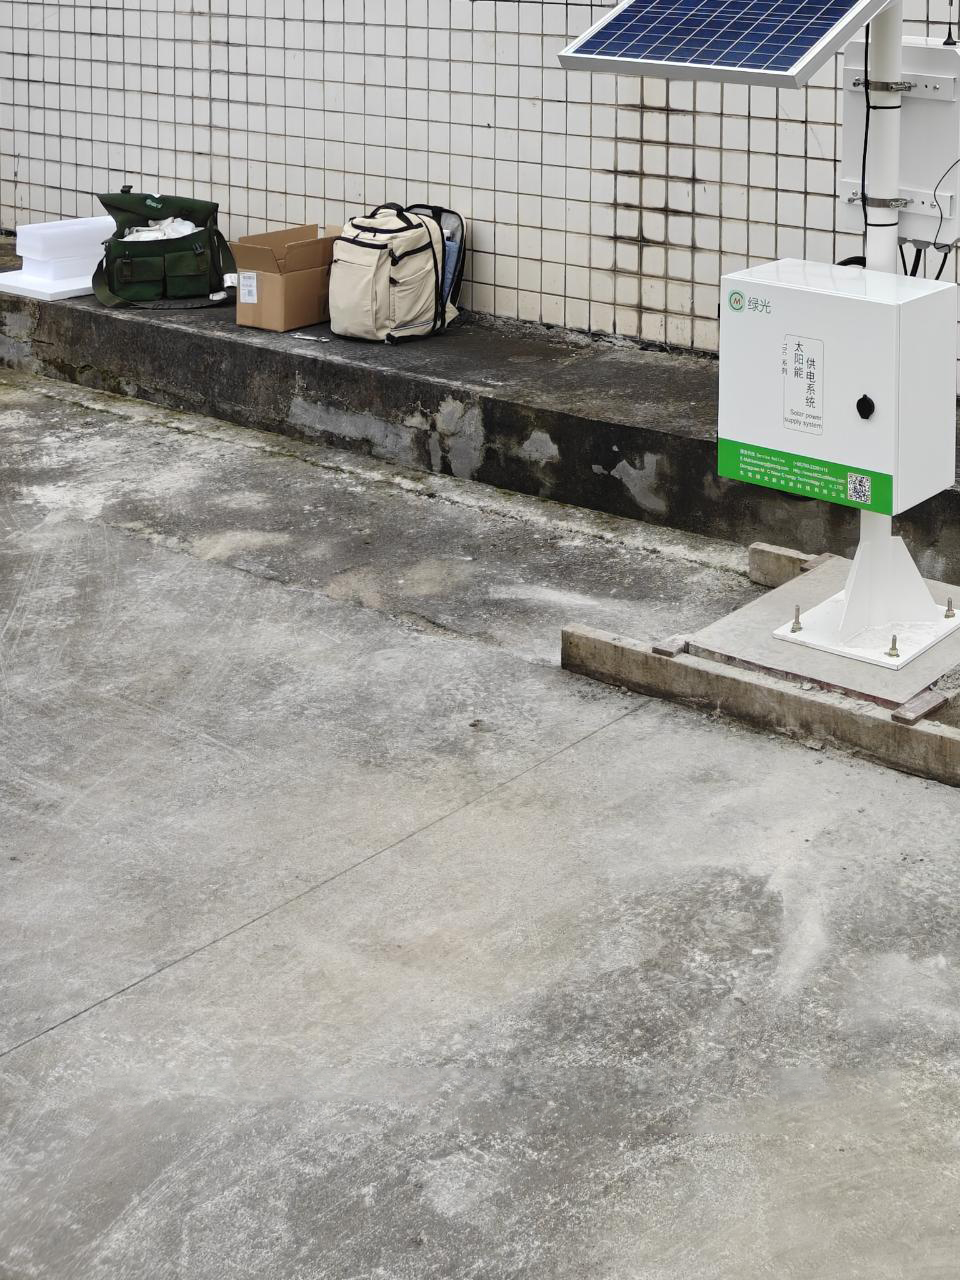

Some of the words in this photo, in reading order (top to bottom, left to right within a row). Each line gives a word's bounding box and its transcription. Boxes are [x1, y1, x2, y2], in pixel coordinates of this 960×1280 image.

[748, 296, 772, 314] 绿光
[794, 340, 804, 379] 太阳能
[805, 357, 816, 409] 供电系统
[784, 416, 802, 426] supply
[803, 420, 823, 429] system
[790, 408, 805, 418] Solar
[806, 412, 822, 421] power
